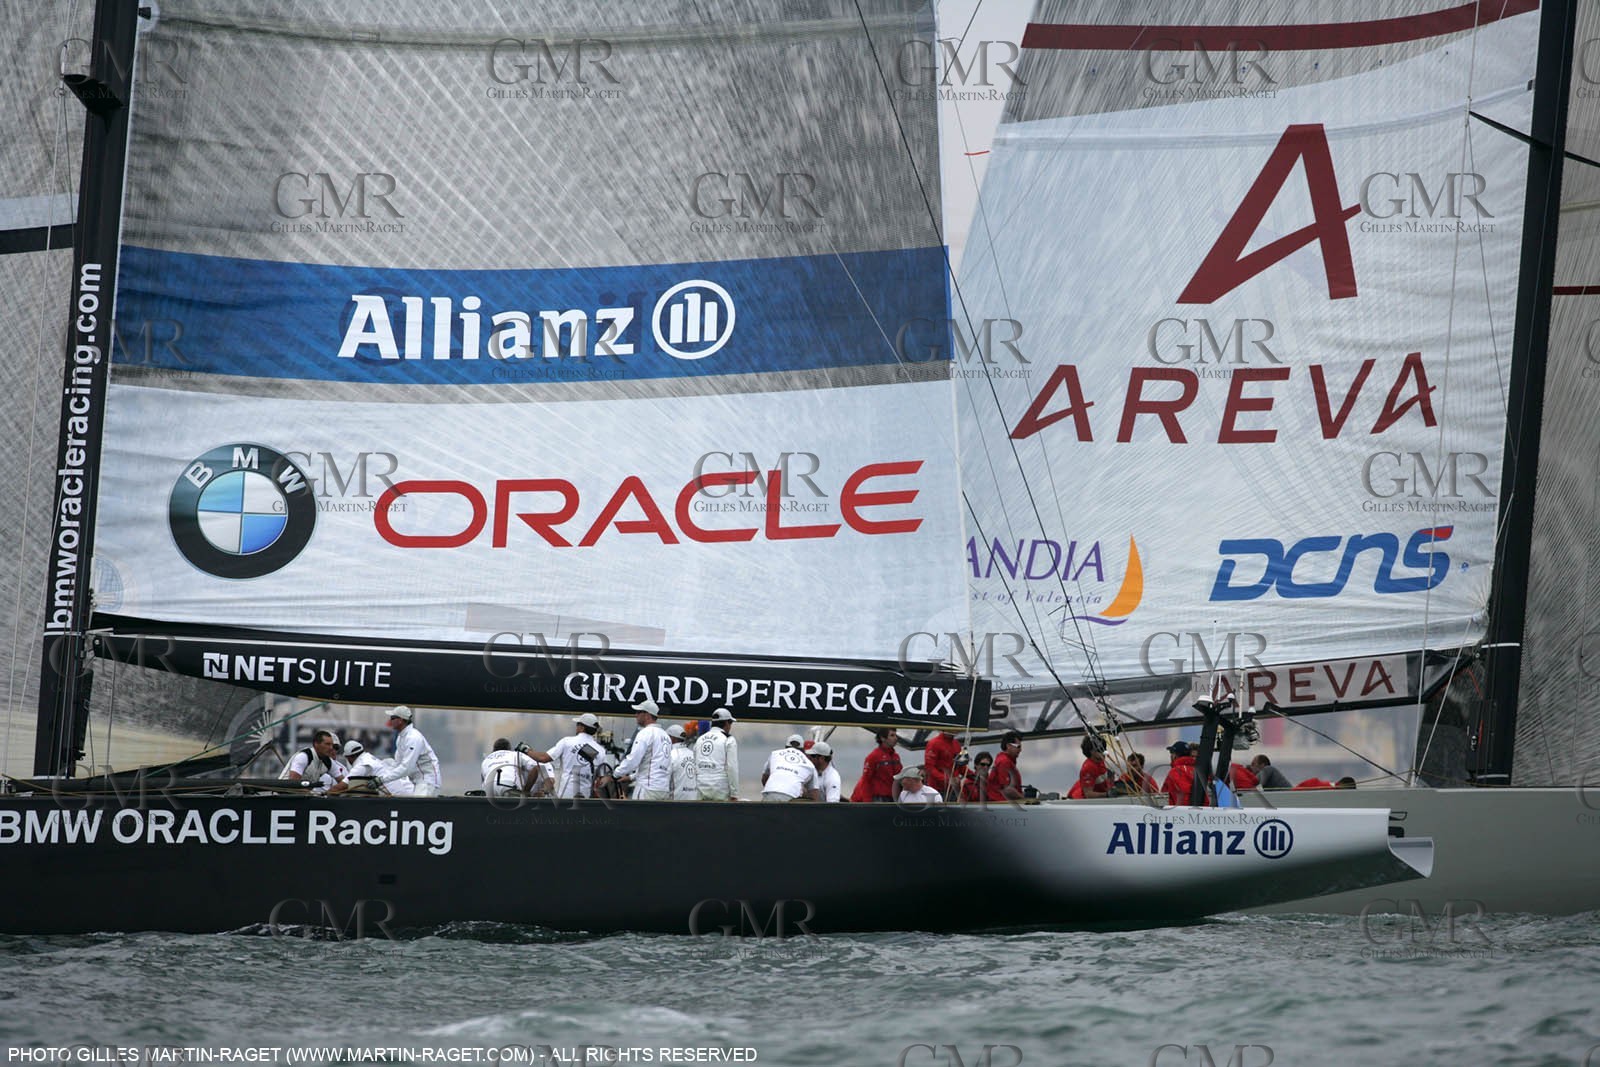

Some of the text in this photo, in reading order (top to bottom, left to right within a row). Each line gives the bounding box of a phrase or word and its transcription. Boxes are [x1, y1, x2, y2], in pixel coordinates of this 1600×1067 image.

[1176, 123, 1361, 304] A
[337, 294, 635, 361] Allianz
[1010, 352, 1437, 444] AREVA
[47, 263, 102, 628] bmworacleracing.com
[184, 447, 306, 493] BMW
[374, 460, 924, 548] ORACLE
[234, 655, 392, 689] NETSUITE
[565, 671, 957, 717] GIRARD-PERREGAUX
[1211, 660, 1395, 708] AREVA
[0, 808, 454, 855] BMW ORACLE Racing
[1106, 822, 1245, 855] Allianz
